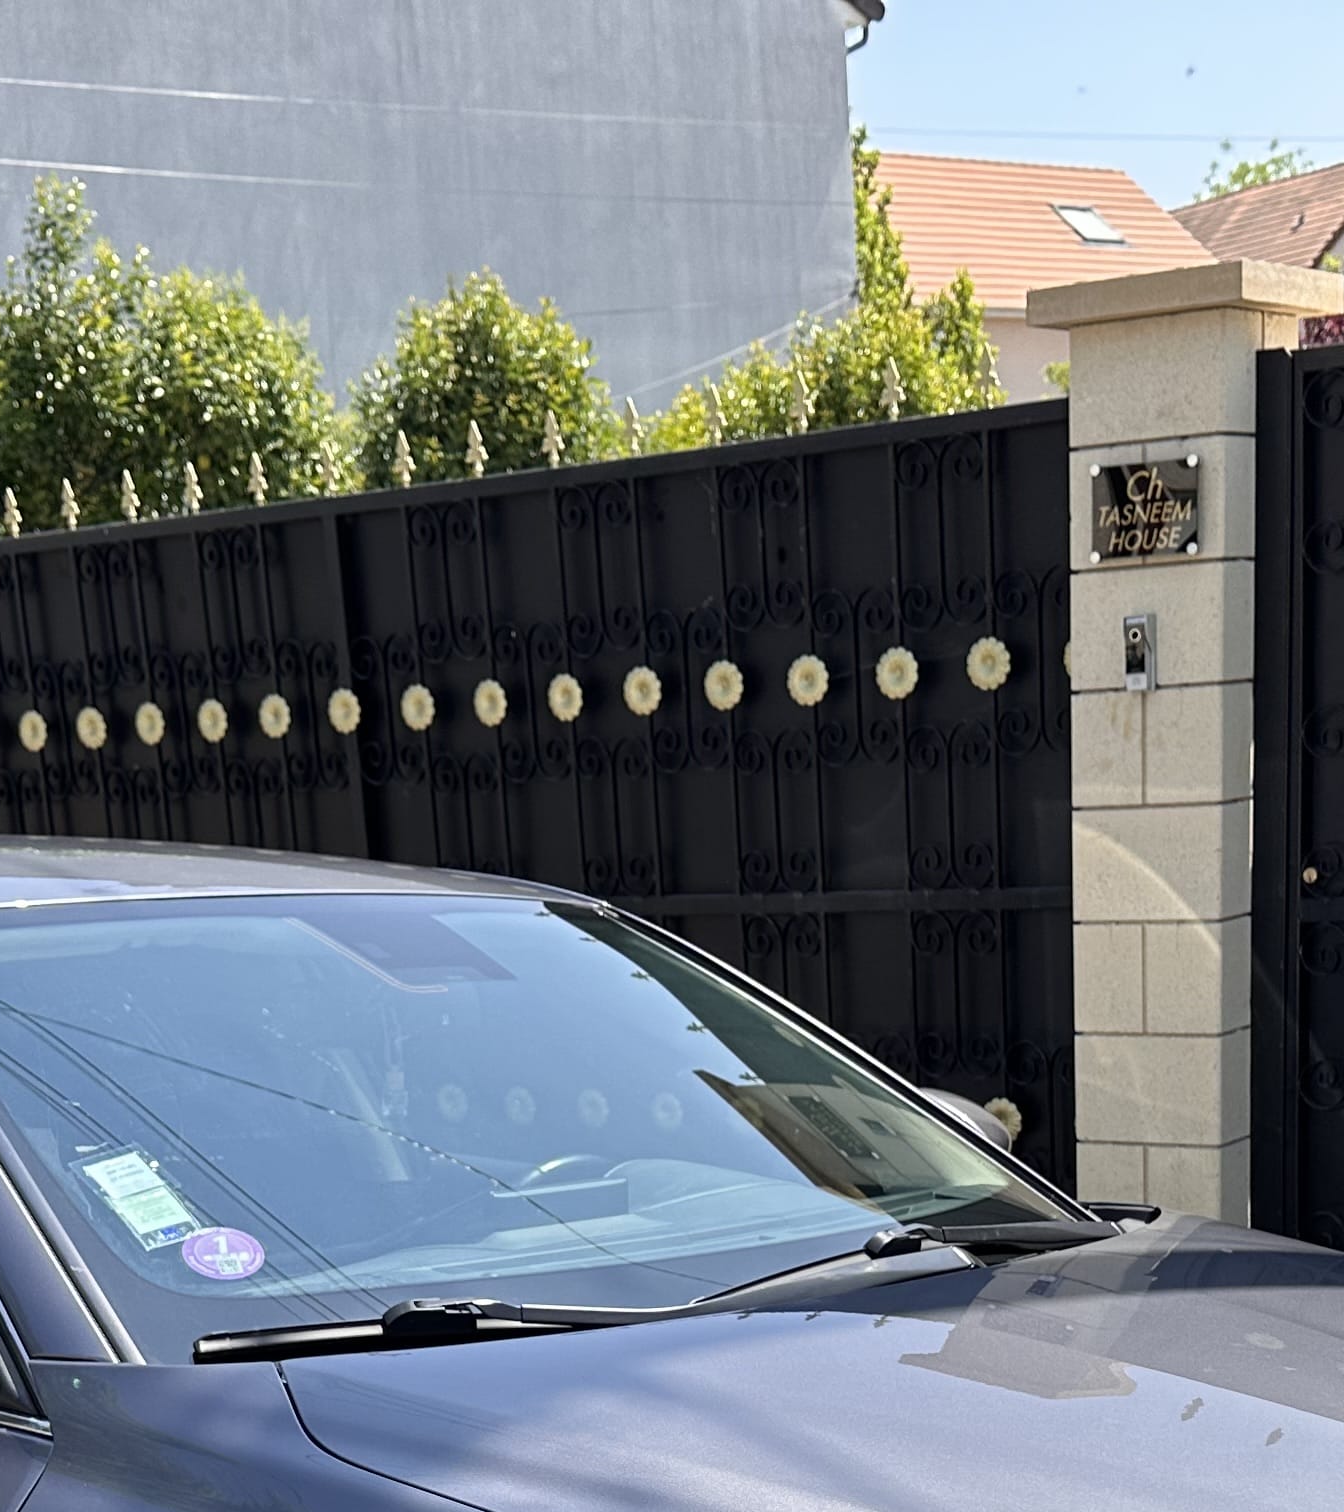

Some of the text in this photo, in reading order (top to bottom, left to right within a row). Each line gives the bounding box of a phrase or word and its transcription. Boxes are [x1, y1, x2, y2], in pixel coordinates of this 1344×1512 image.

[1127, 467, 1163, 502] Ch
[1098, 499, 1192, 528] TASNEEM
[1109, 526, 1182, 552] HOUSE
[212, 1235, 229, 1255] 1
